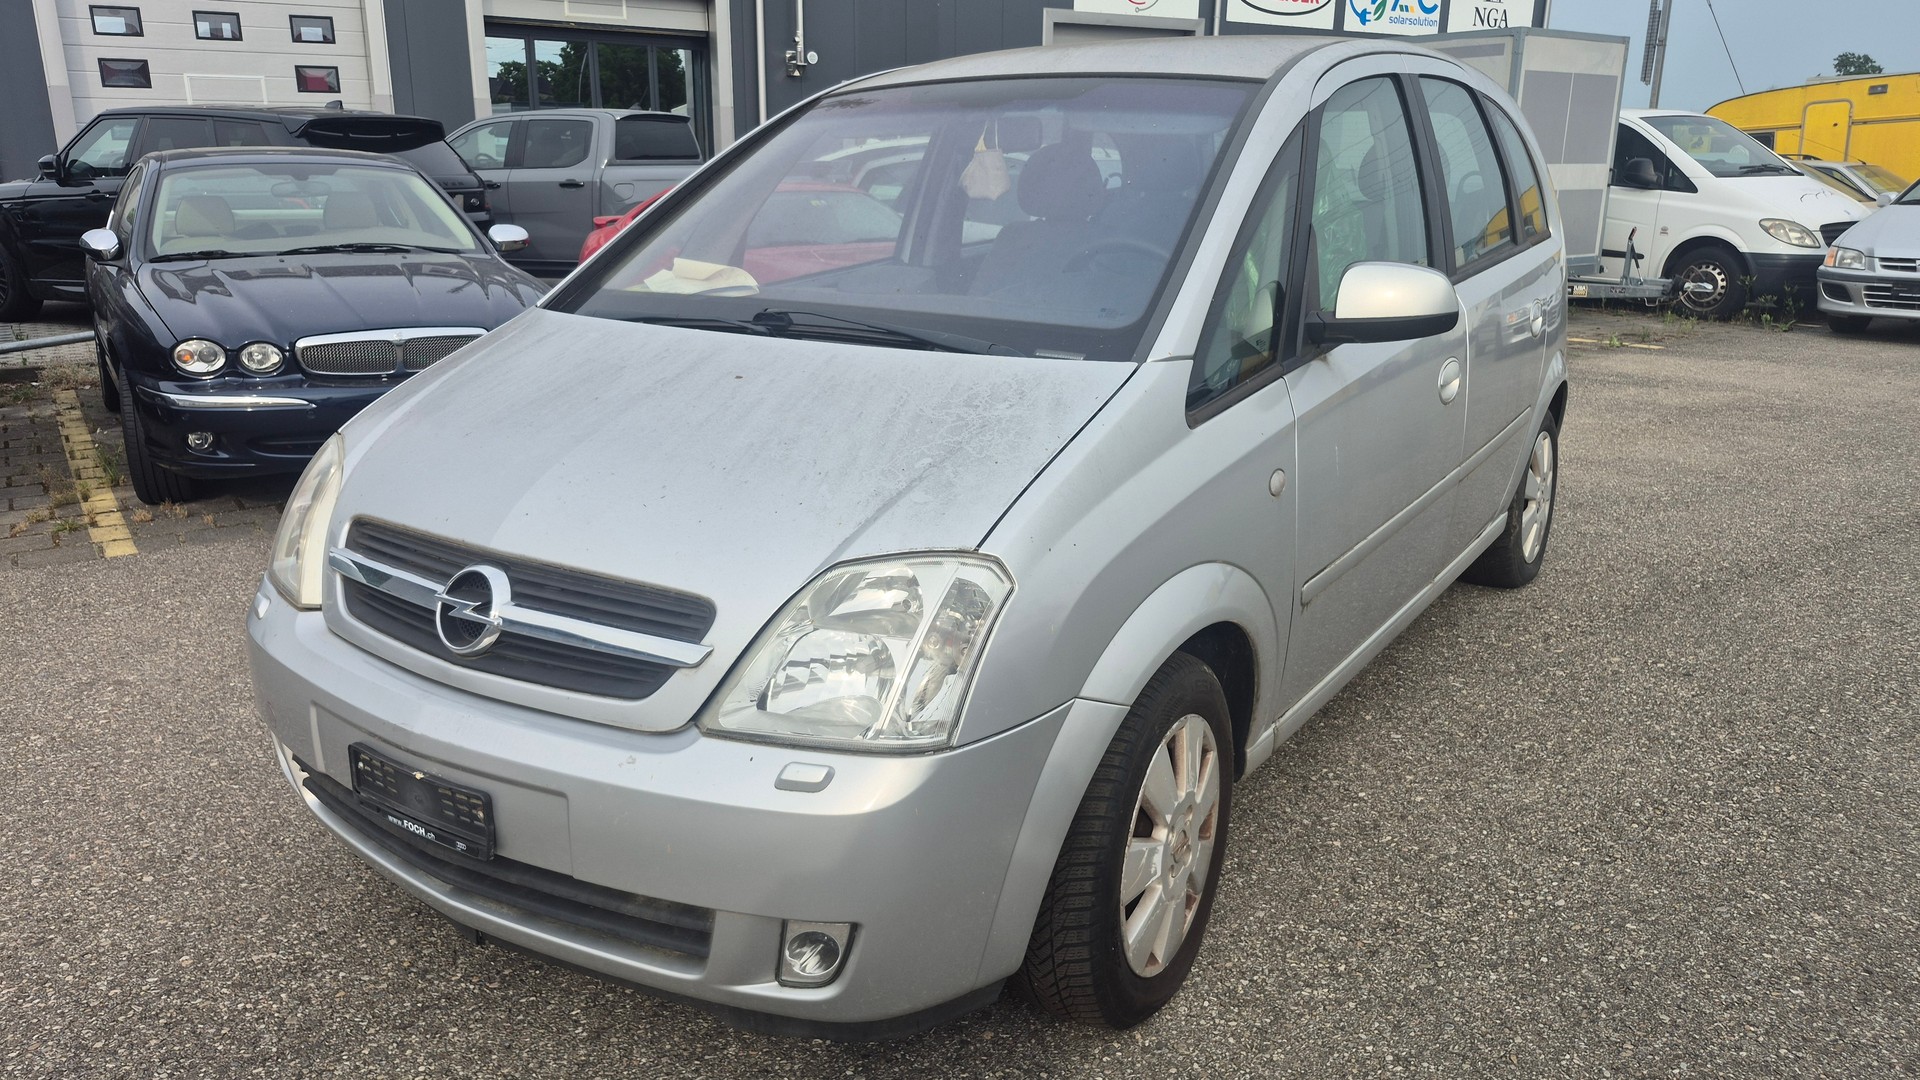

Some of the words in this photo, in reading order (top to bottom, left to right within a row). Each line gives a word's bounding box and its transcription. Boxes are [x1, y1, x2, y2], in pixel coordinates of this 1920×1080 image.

[1388, 15, 1438, 27] solarsolution
[1472, 6, 1509, 29] NGA
[387, 814, 436, 841] www.FOCH.ch
